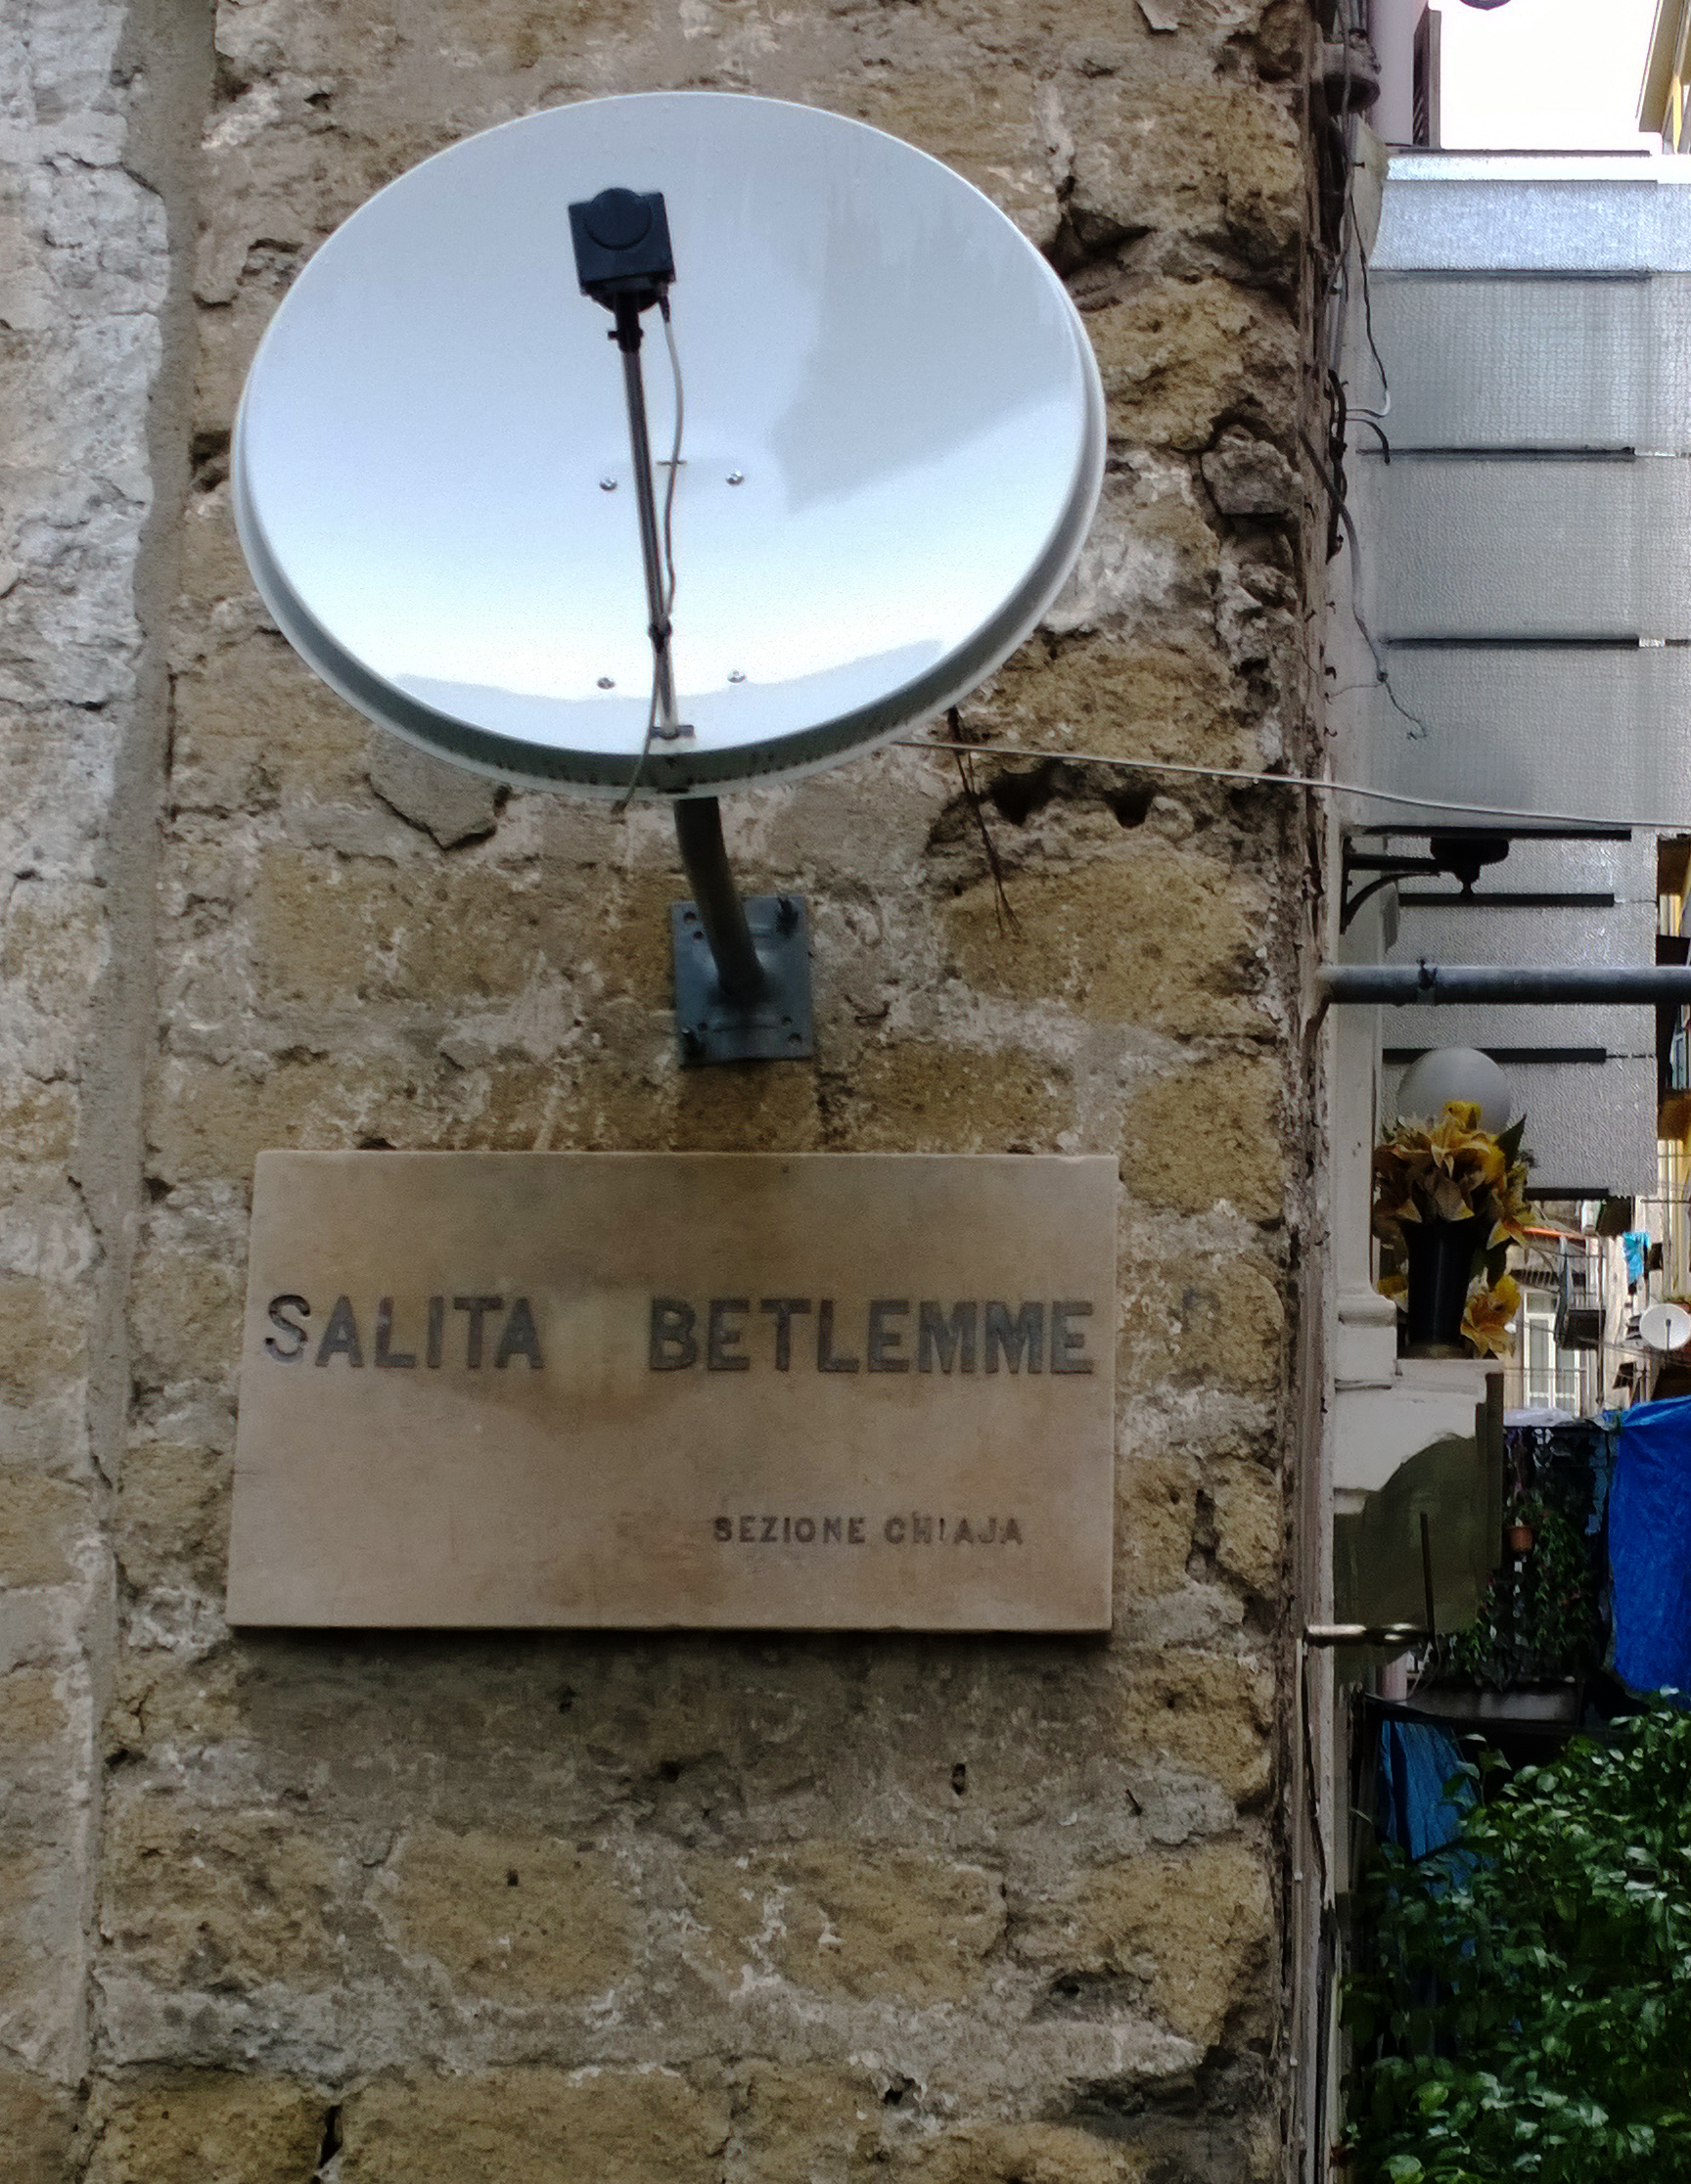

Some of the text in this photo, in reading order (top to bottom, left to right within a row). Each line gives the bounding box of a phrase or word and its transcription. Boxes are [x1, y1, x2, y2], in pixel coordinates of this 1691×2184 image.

[265, 1295, 1095, 1374] SALITA BETLEMME
[714, 1515, 1024, 1545] SEZIONE CHIAJA
